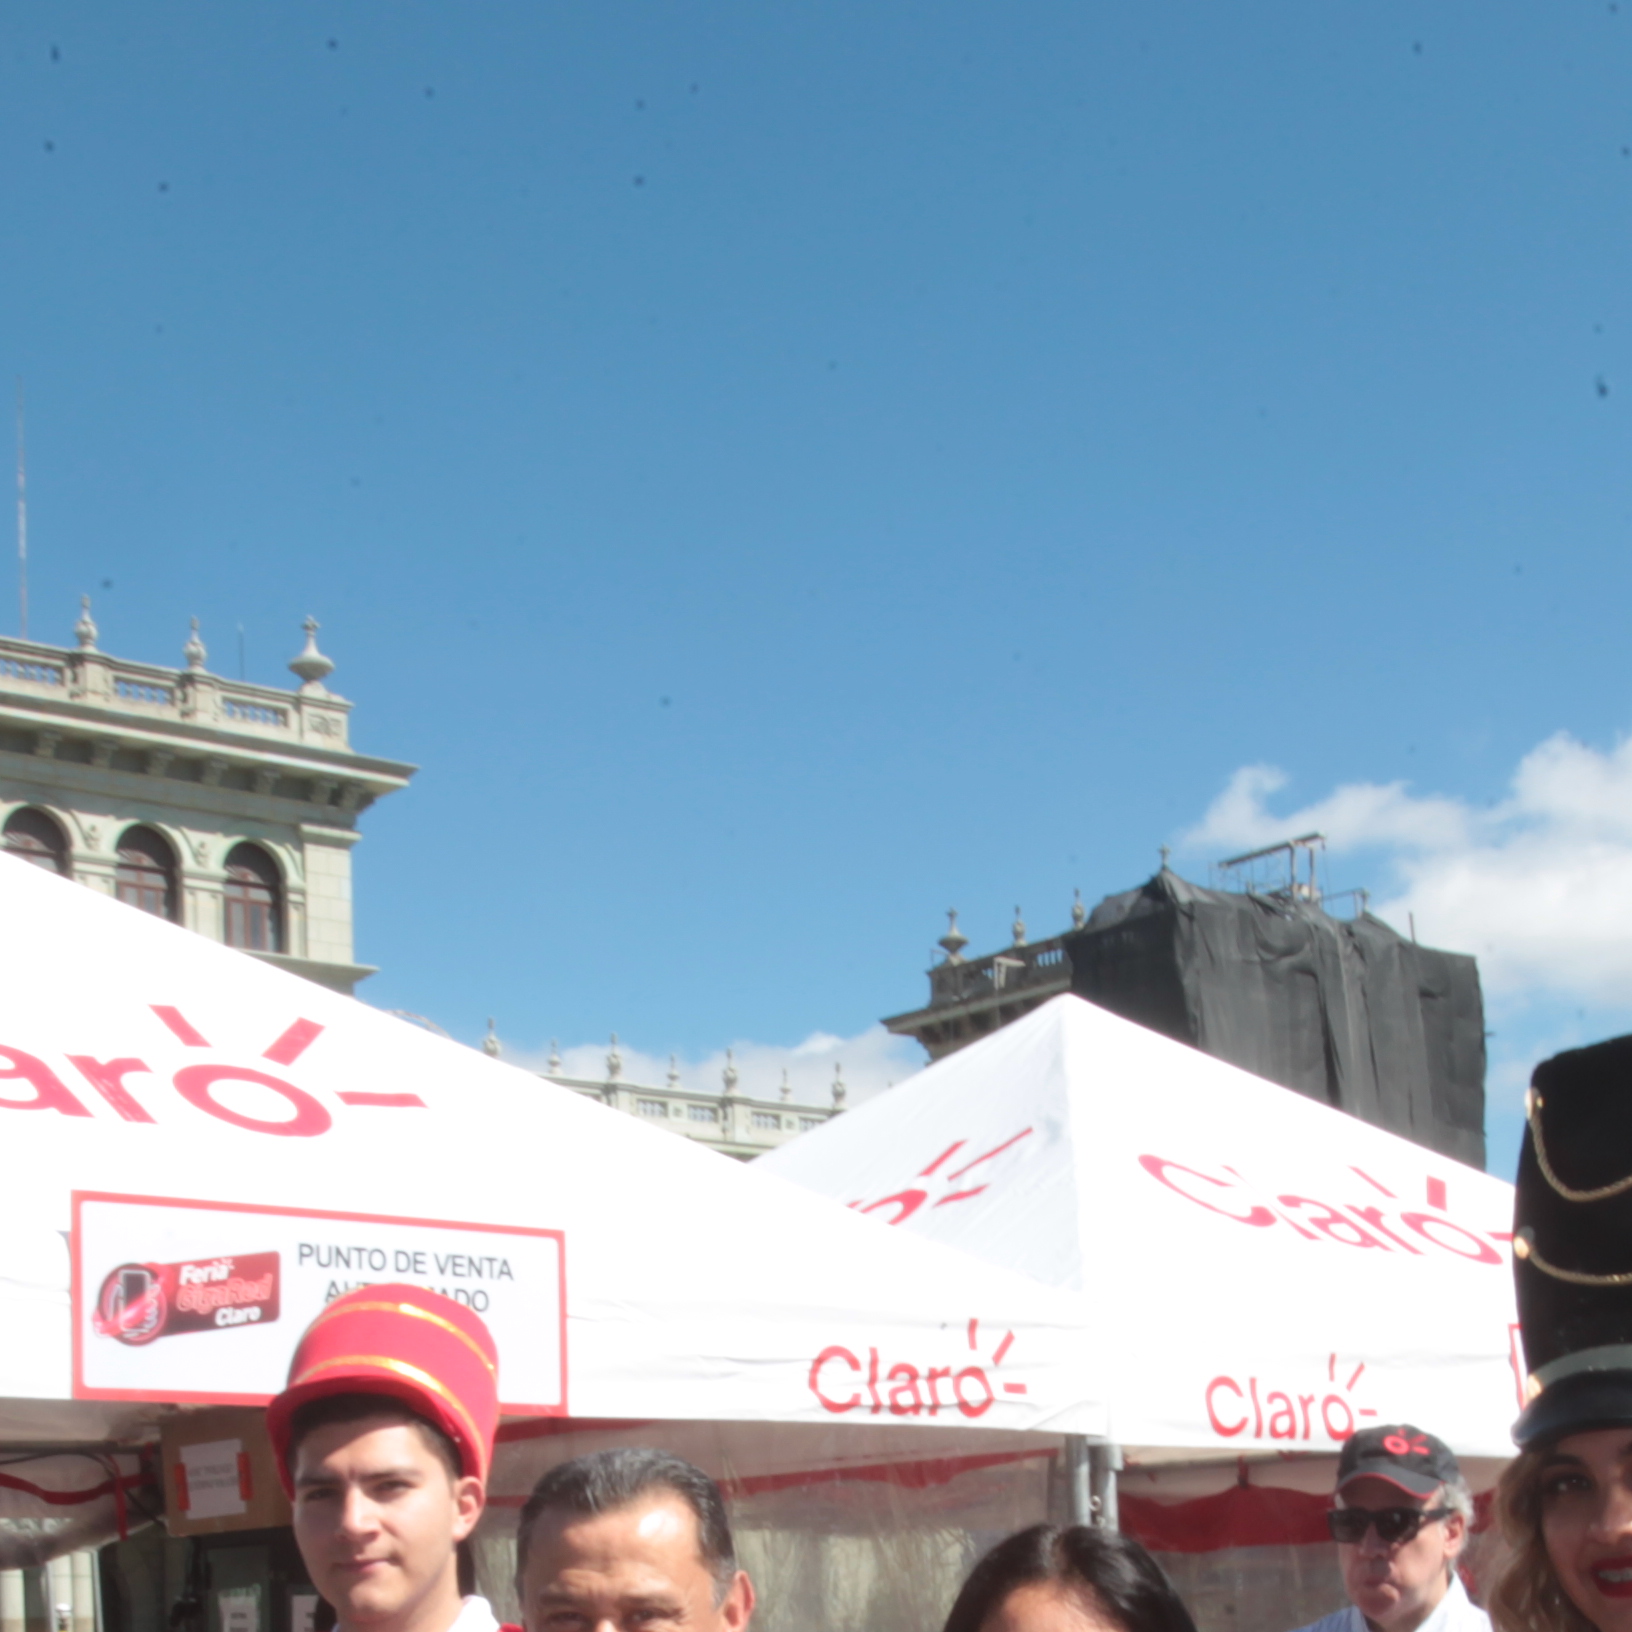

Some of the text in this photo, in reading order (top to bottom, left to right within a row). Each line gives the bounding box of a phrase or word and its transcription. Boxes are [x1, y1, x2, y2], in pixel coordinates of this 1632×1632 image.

[1137, 1152, 1504, 1266] Claro
[179, 1260, 229, 1285] Feria
[297, 1242, 516, 1281] PUNTO DE VENTA
[215, 1306, 262, 1328] Claro
[807, 1344, 997, 1419] Claro
[1204, 1374, 1355, 1441] Claro
